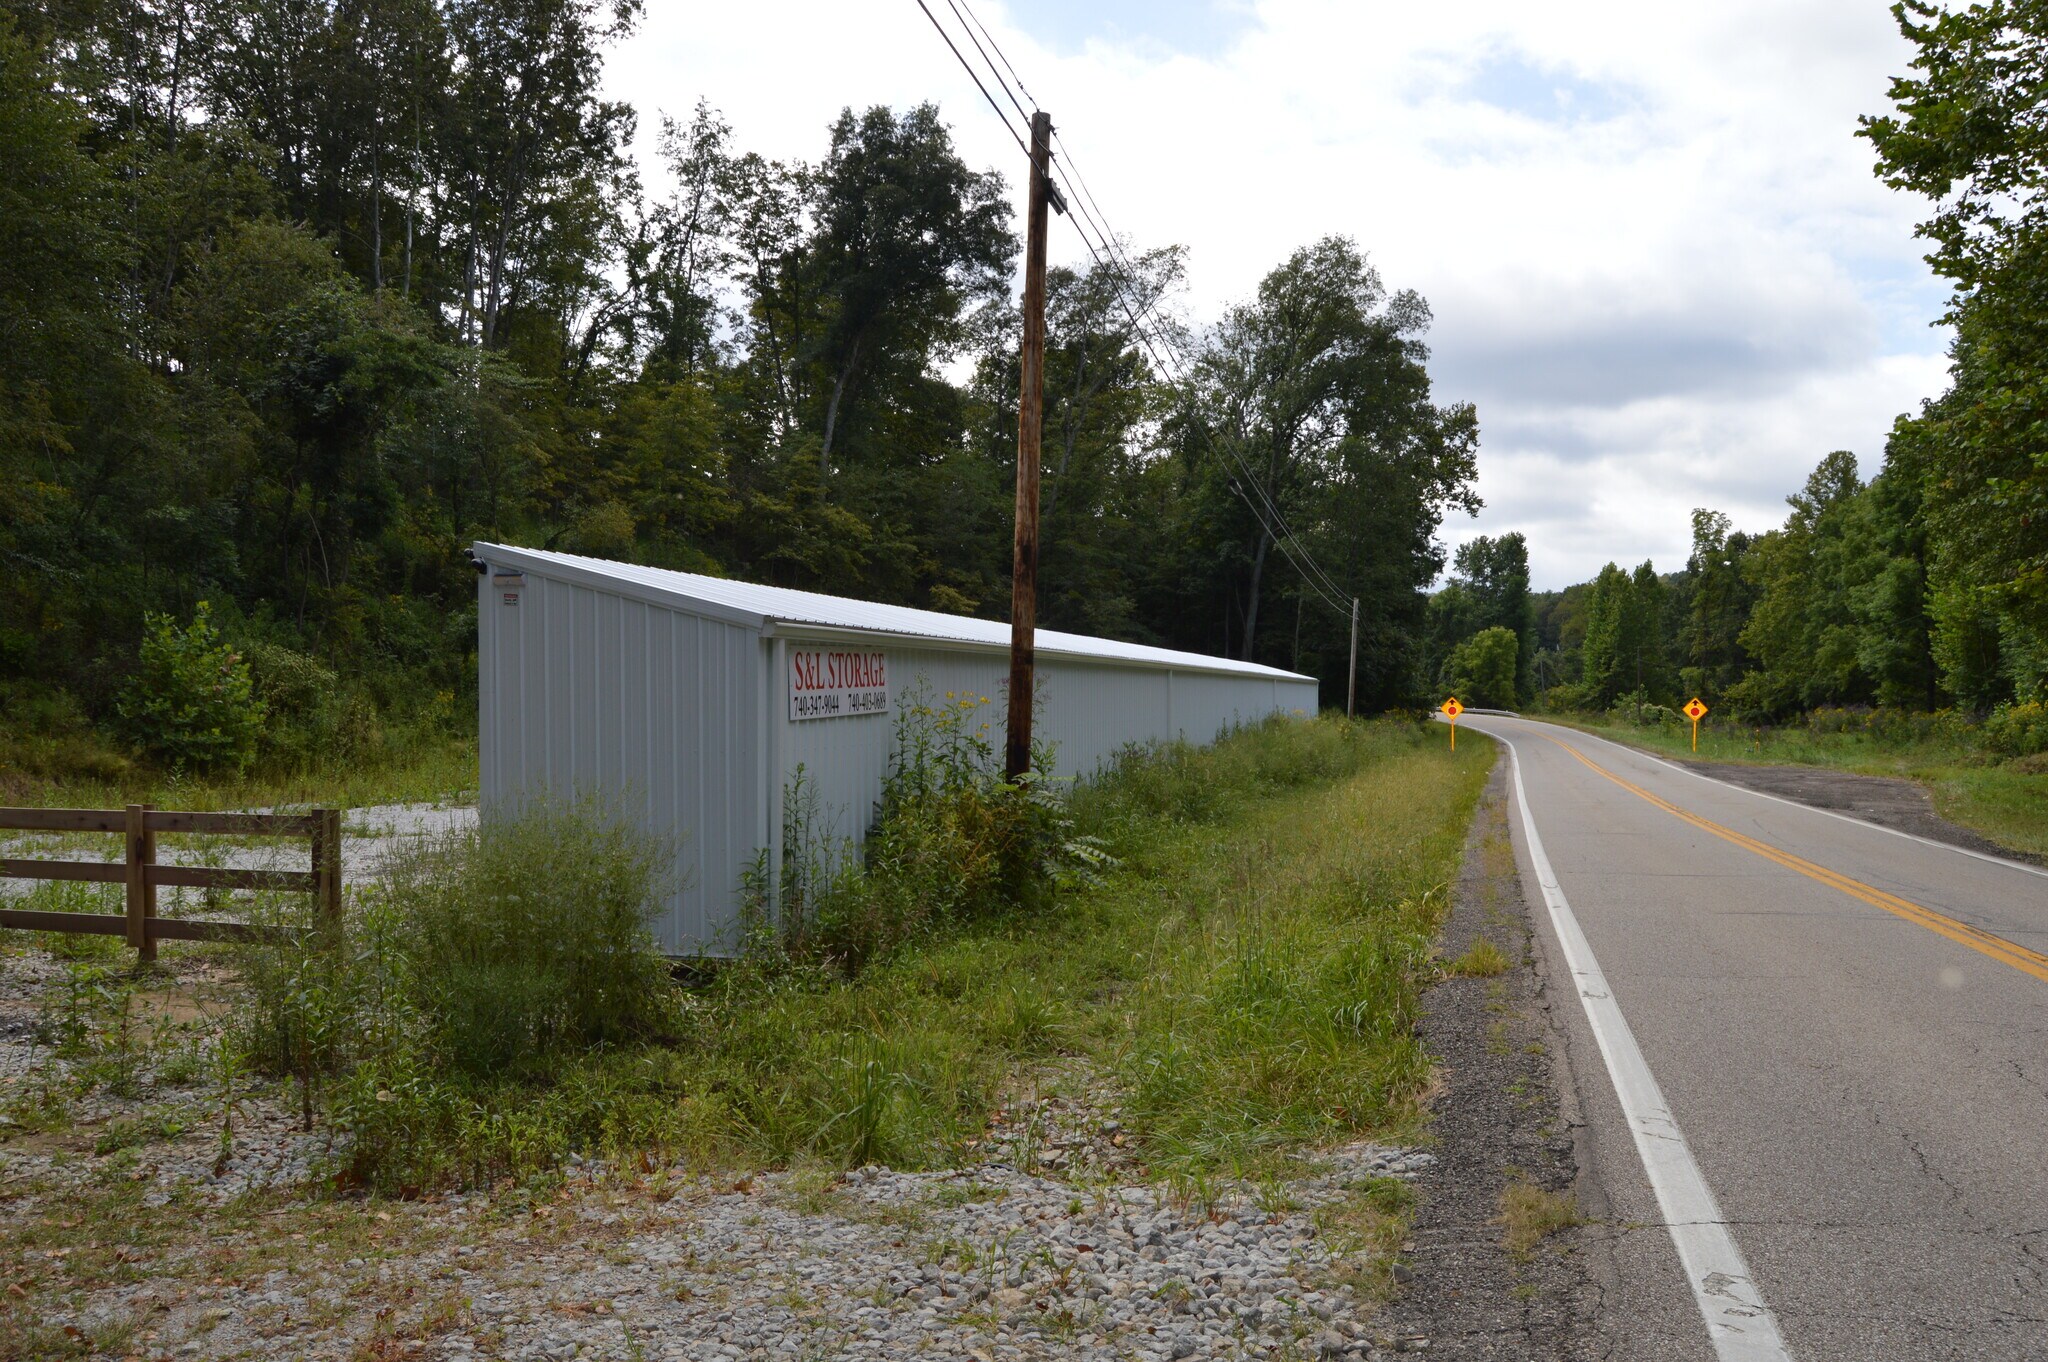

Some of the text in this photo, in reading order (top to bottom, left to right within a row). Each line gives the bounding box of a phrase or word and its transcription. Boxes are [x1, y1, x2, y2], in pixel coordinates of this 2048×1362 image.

[795, 652, 885, 690] S&L STORAGE
[794, 695, 839, 716] 740-347-9044
